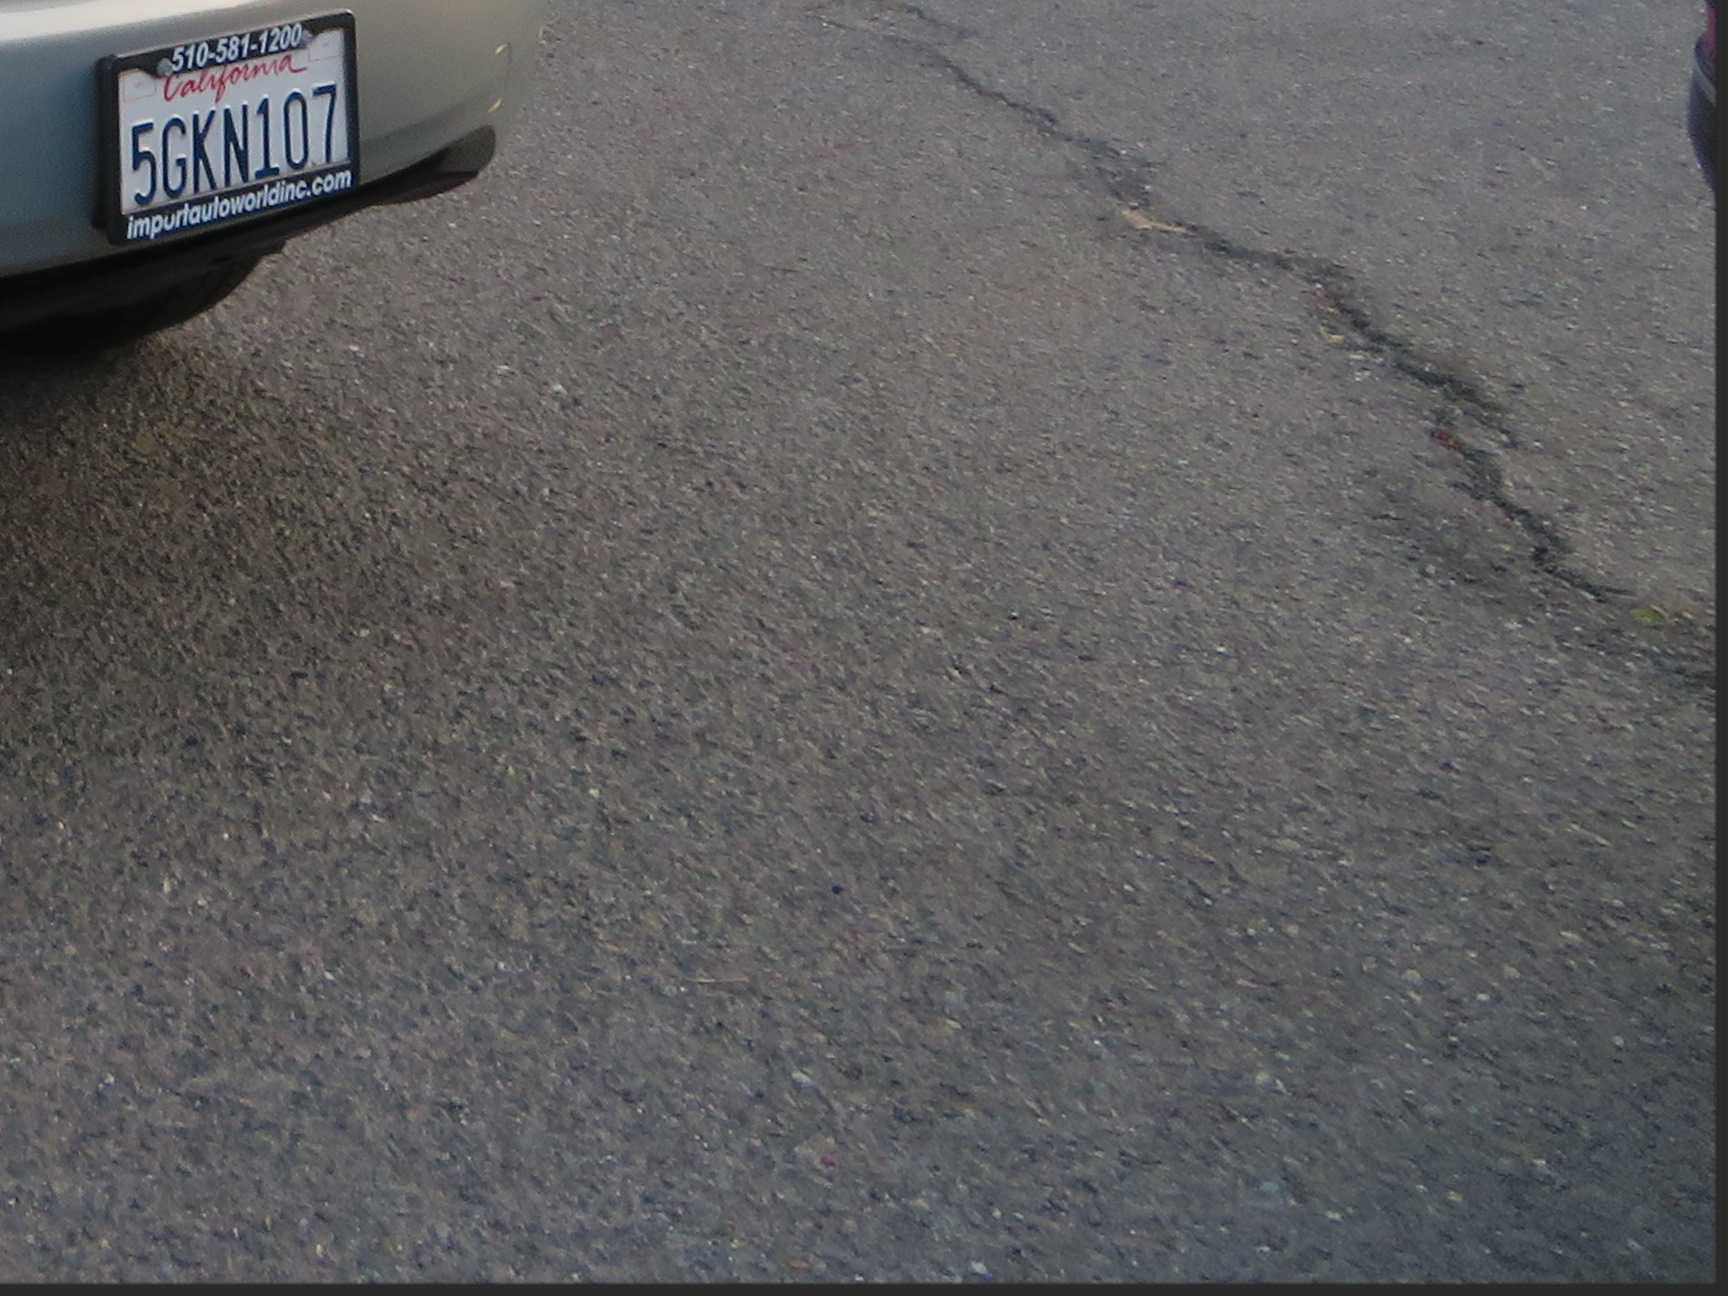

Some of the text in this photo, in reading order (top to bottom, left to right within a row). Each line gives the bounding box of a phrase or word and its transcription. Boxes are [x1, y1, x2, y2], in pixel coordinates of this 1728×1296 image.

[162, 51, 309, 102] California
[171, 22, 304, 72] 510-581-1200
[131, 81, 338, 207] 5GKN107
[127, 169, 352, 241] importautoworldinc.com
